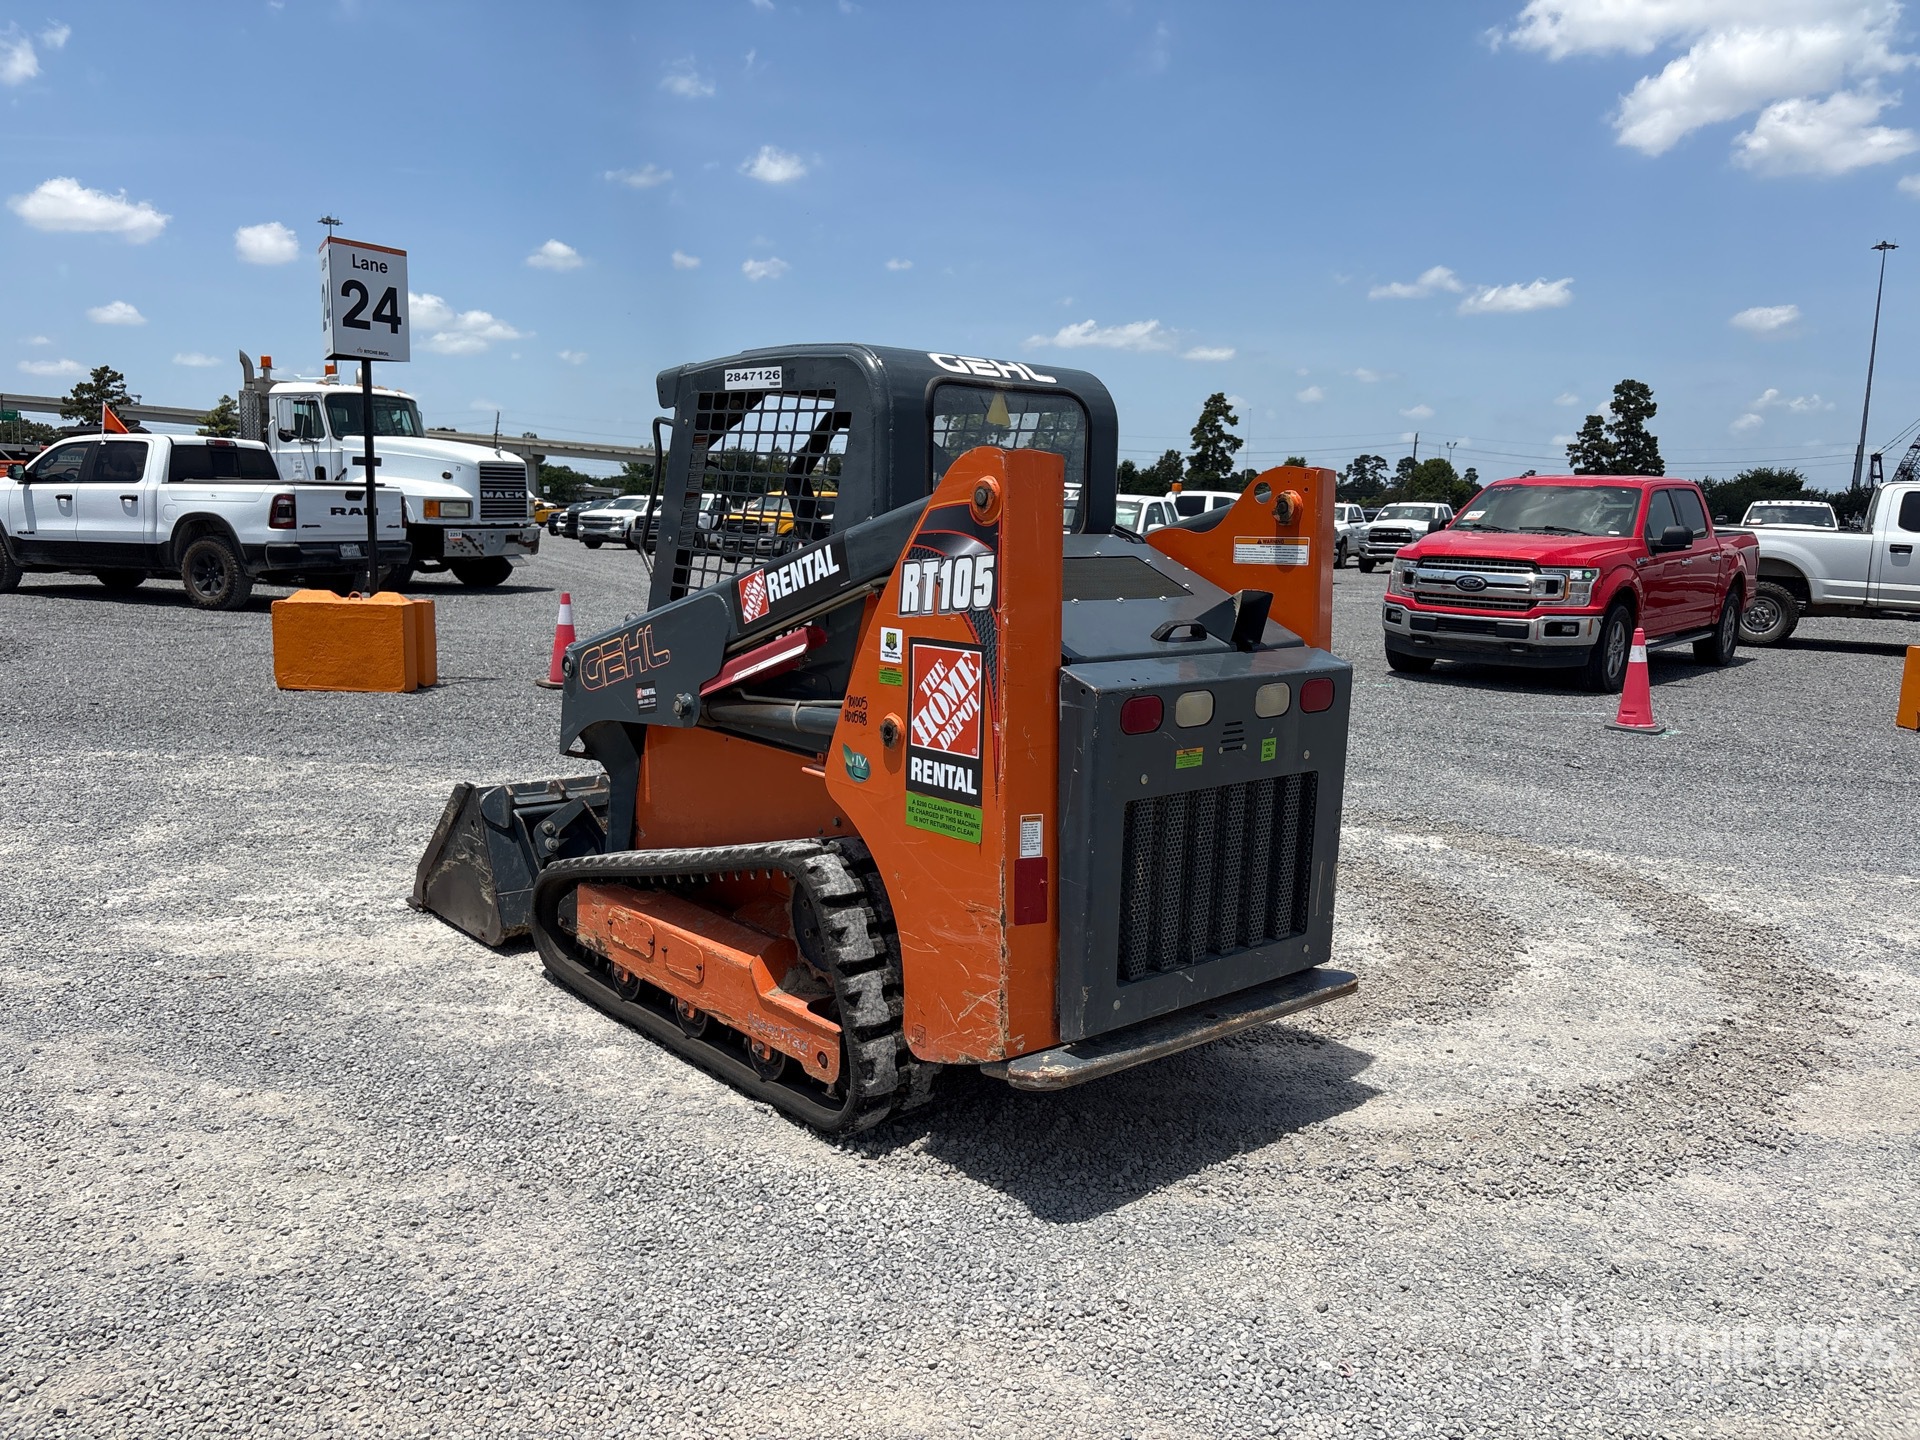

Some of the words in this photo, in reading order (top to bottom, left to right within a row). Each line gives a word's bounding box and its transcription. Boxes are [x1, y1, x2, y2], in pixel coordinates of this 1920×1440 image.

[352, 253, 388, 273] Lane
[341, 279, 402, 335] 24
[726, 370, 781, 382] 2847126
[926, 352, 1058, 384] GEHL
[482, 491, 525, 499] MACK
[766, 544, 840, 603] RENTAL
[899, 552, 995, 617] RT105
[743, 570, 766, 621] HOME
[580, 624, 671, 691] GEHL
[919, 658, 948, 698] THE
[912, 650, 982, 747] HOME
[937, 690, 981, 752] DEPOT
[910, 756, 978, 796] RENTAL
[915, 807, 940, 819] CHARGED
[945, 815, 957, 824] THIS
[957, 818, 980, 830] MACHINE
[919, 817, 929, 825] NOT
[929, 819, 957, 832] RETURNED
[956, 827, 974, 837] CLEAN
[927, 802, 953, 815] CLEANING
[953, 808, 964, 817] FEE
[964, 812, 976, 821] WILL
